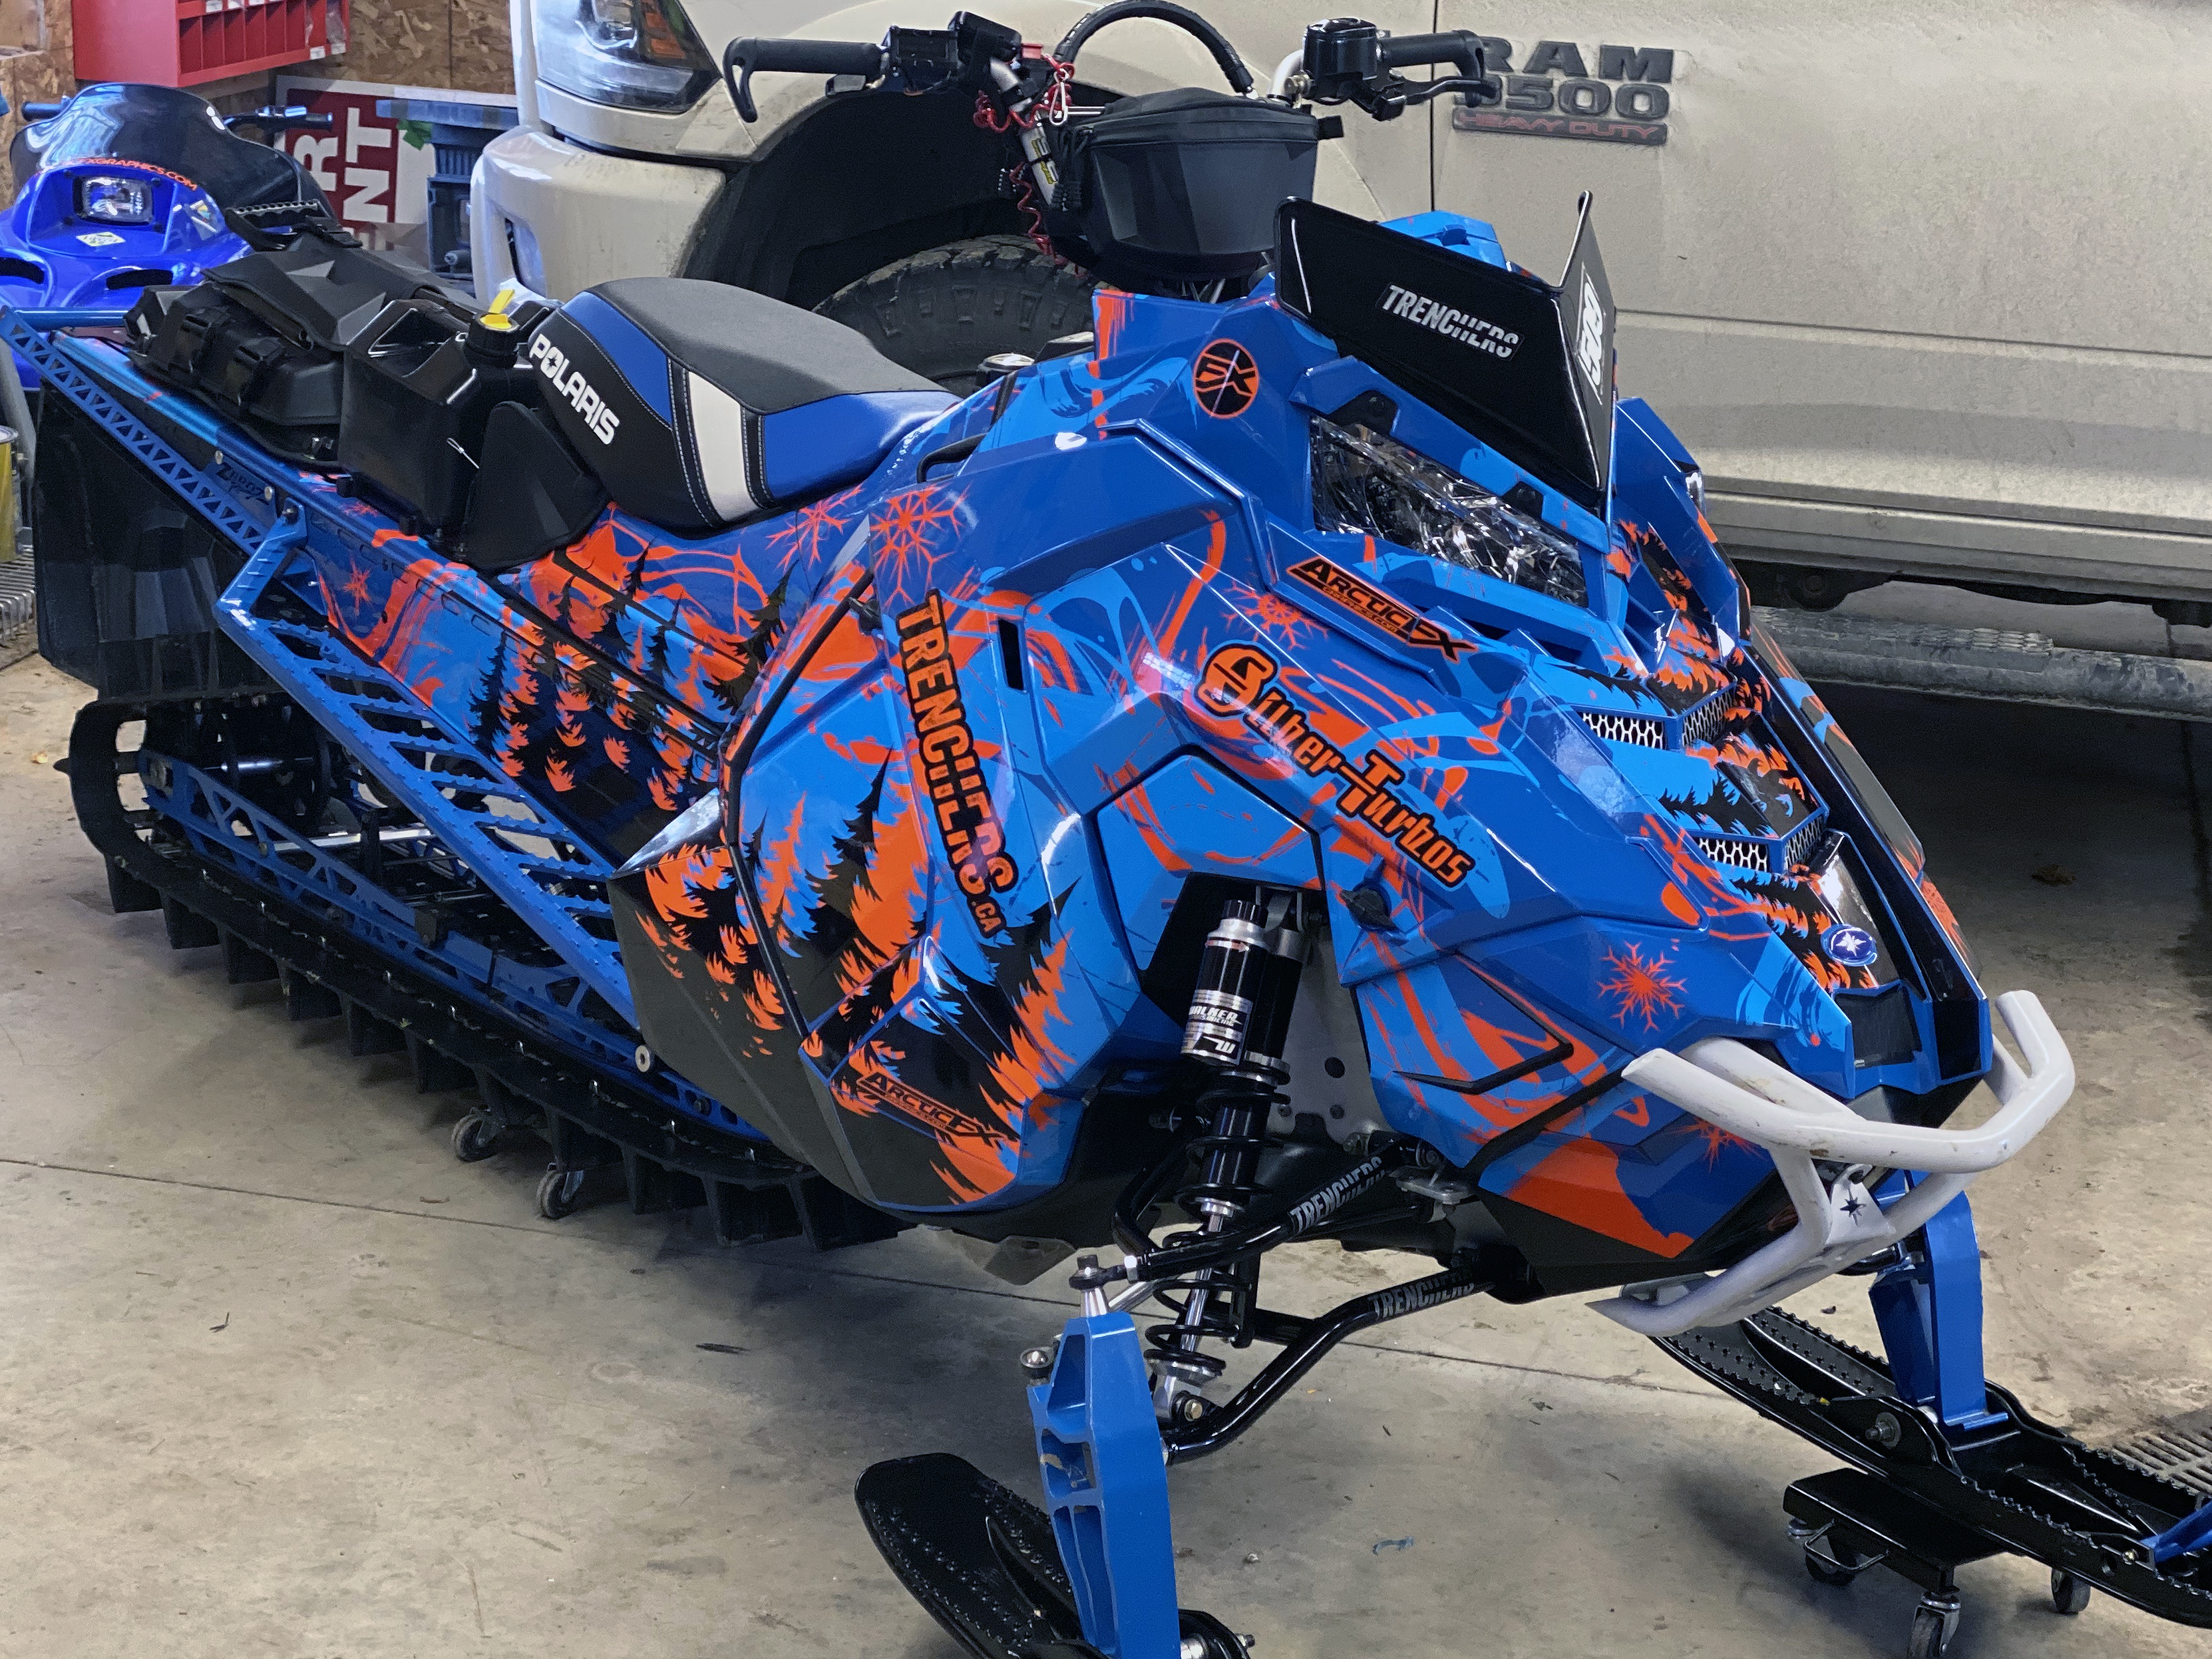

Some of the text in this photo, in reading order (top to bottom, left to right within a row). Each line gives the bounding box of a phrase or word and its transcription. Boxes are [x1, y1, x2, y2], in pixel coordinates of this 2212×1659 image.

[1483, 35, 1674, 83] RAM
[1457, 112, 1659, 138] HEAVY DUTY
[1382, 284, 1519, 358] TRENCHERS
[529, 333, 620, 445] POLARIS
[1290, 1156, 1385, 1232] TRENCHERS
[1368, 1273, 1475, 1321] TRENCHERS
